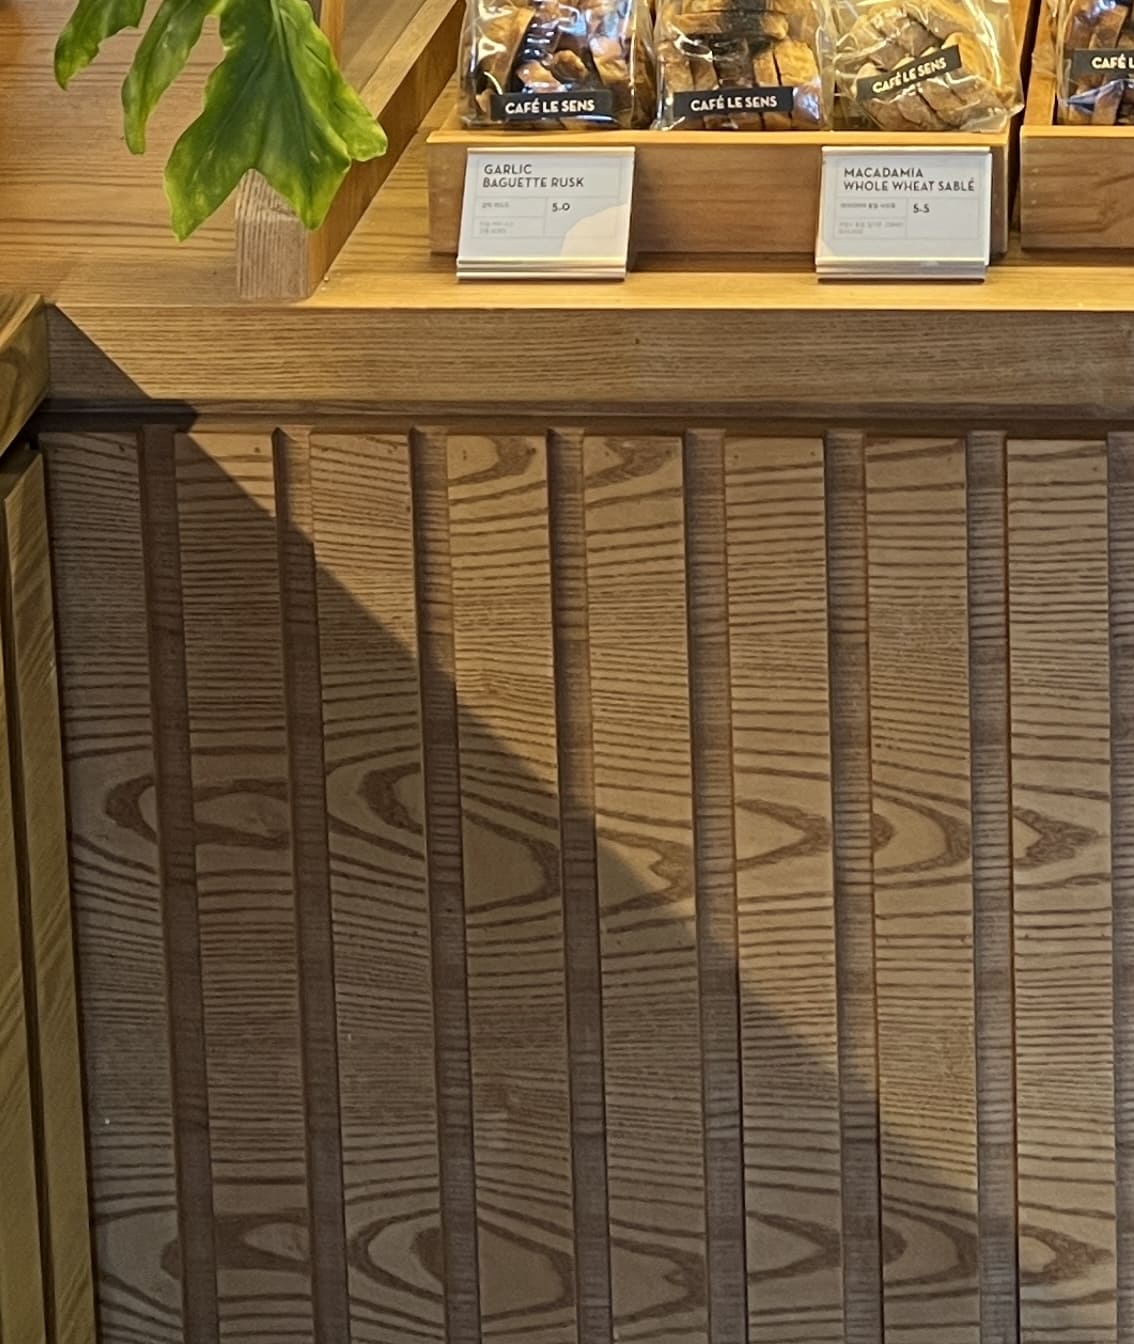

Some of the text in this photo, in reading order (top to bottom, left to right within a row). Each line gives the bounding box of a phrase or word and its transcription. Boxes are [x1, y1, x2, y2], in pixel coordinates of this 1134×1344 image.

[1091, 53, 1126, 69] CAFÉ
[872, 57, 947, 93] CAFÉ LE SENS
[505, 97, 595, 114] CAFÉ LE SENS
[690, 95, 778, 111] CAFÉ LE SENS
[484, 164, 532, 175] GARLIC
[844, 167, 924, 178] MACADAMIA
[482, 177, 584, 188] BAGUETTE RUSK
[844, 177, 975, 191] WHOLE WHEAT SABLÉ
[552, 202, 571, 212] 5.0
[913, 203, 930, 213] 5.5
